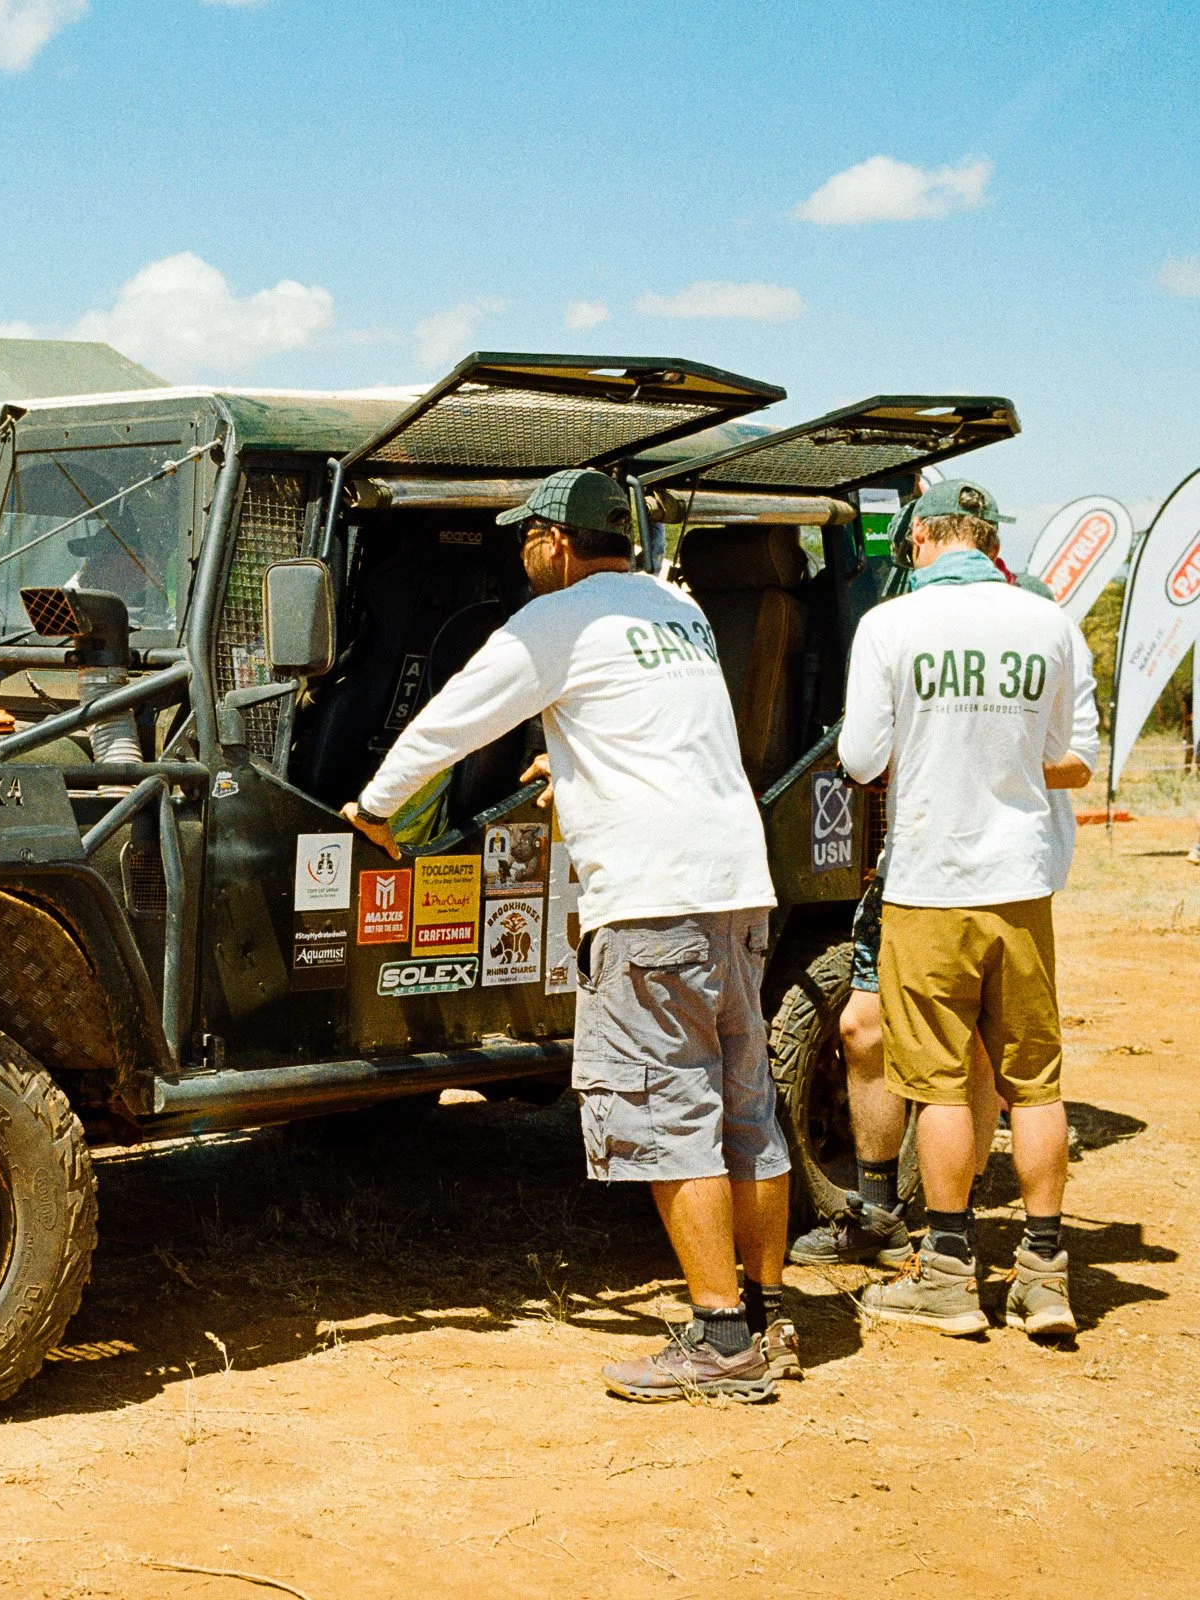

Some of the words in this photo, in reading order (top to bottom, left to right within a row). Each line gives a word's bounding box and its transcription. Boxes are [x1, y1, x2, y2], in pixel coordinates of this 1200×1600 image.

[439, 531, 482, 543] sparco
[1050, 519, 1107, 595] APYRUS
[626, 621, 702, 670] CAR
[913, 650, 986, 701] CAR
[999, 651, 1046, 702] 30
[396, 662, 420, 718] ATS
[936, 705, 951, 714] THE
[955, 704, 979, 713] GREEN
[814, 840, 852, 865] USN
[421, 864, 474, 876] TOOLCRAFTS
[365, 911, 403, 923] MAXXIS
[487, 902, 541, 927] BROOKHOUSE
[419, 927, 471, 942] CRAFTSMAN
[296, 947, 344, 964] Aquamist
[382, 964, 474, 988] SOLEX
[487, 967, 508, 976] RHINO
[511, 966, 536, 974] CHARGE
[394, 983, 458, 995] MOTORS
